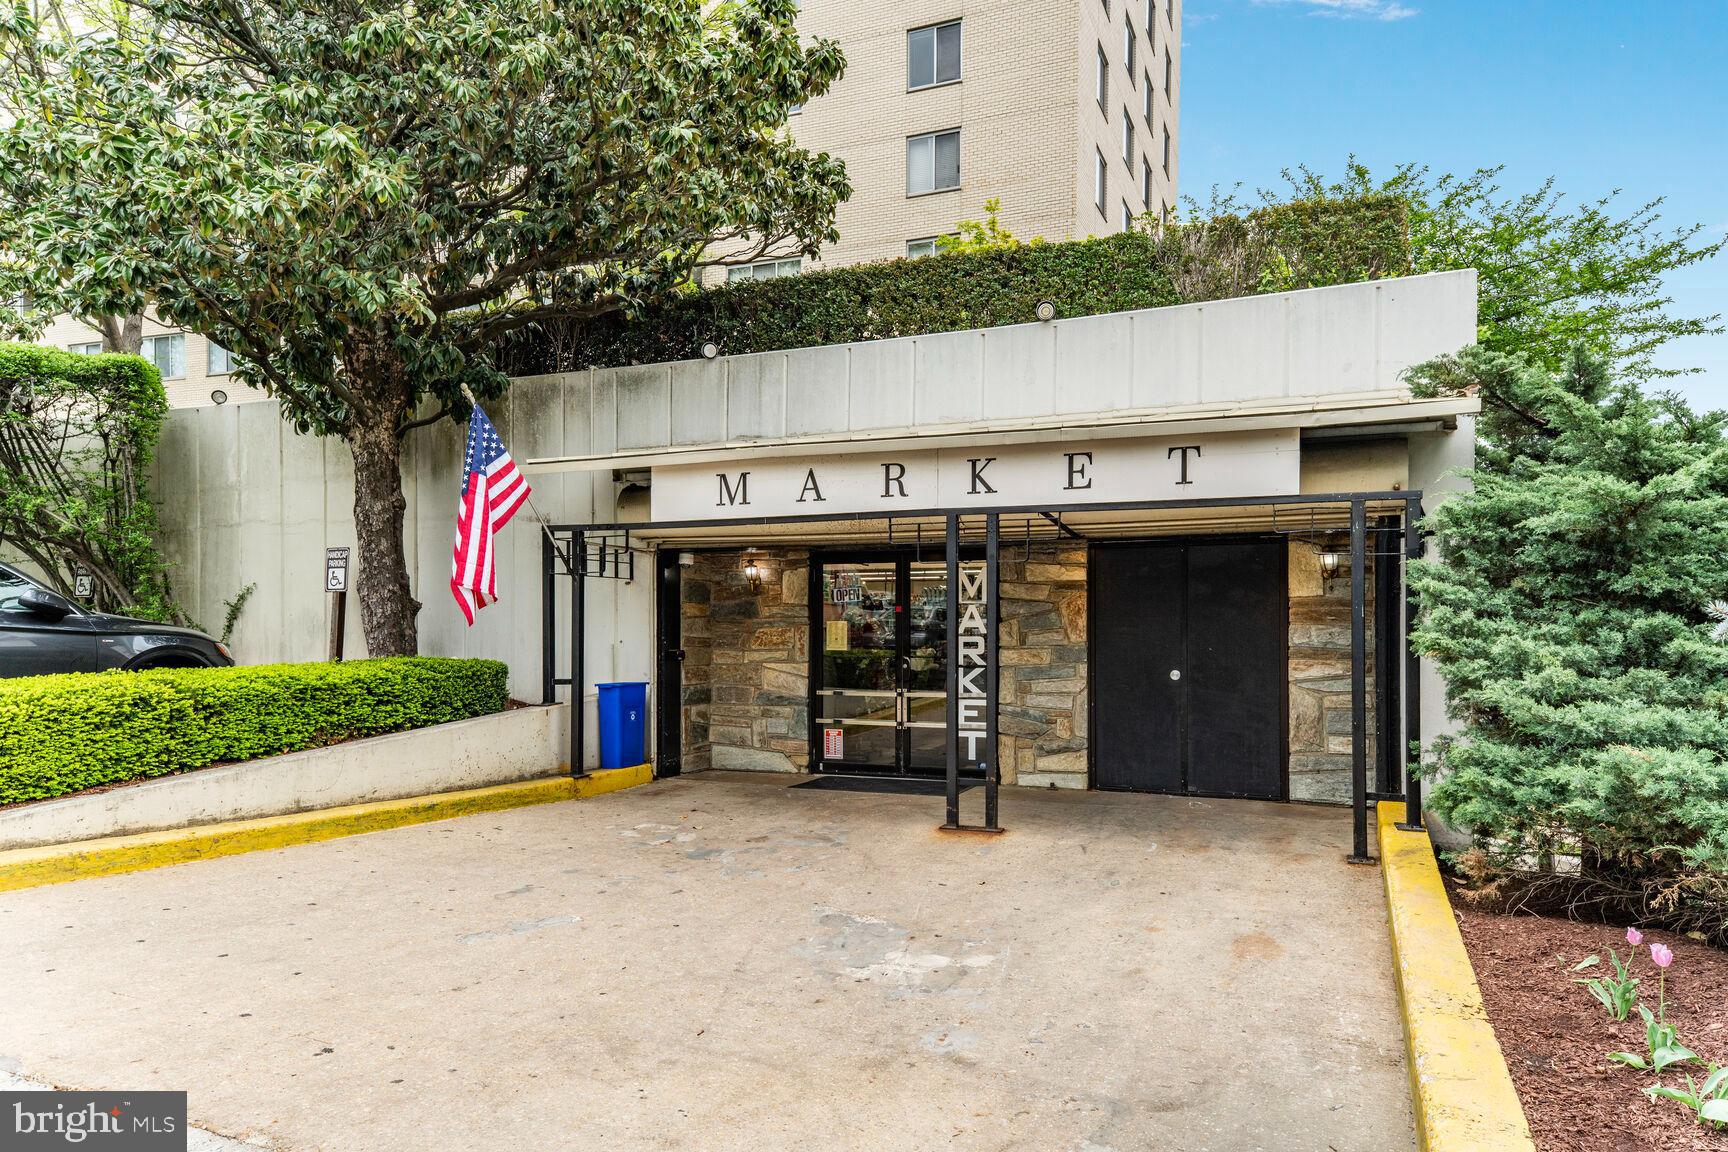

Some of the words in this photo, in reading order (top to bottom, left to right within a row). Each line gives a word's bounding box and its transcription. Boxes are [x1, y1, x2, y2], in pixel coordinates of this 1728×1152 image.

[715, 445, 1201, 507] MARKET
[328, 559, 346, 567] PARKING
[835, 588, 860, 602] OPEN
[958, 566, 987, 761] MARKET
